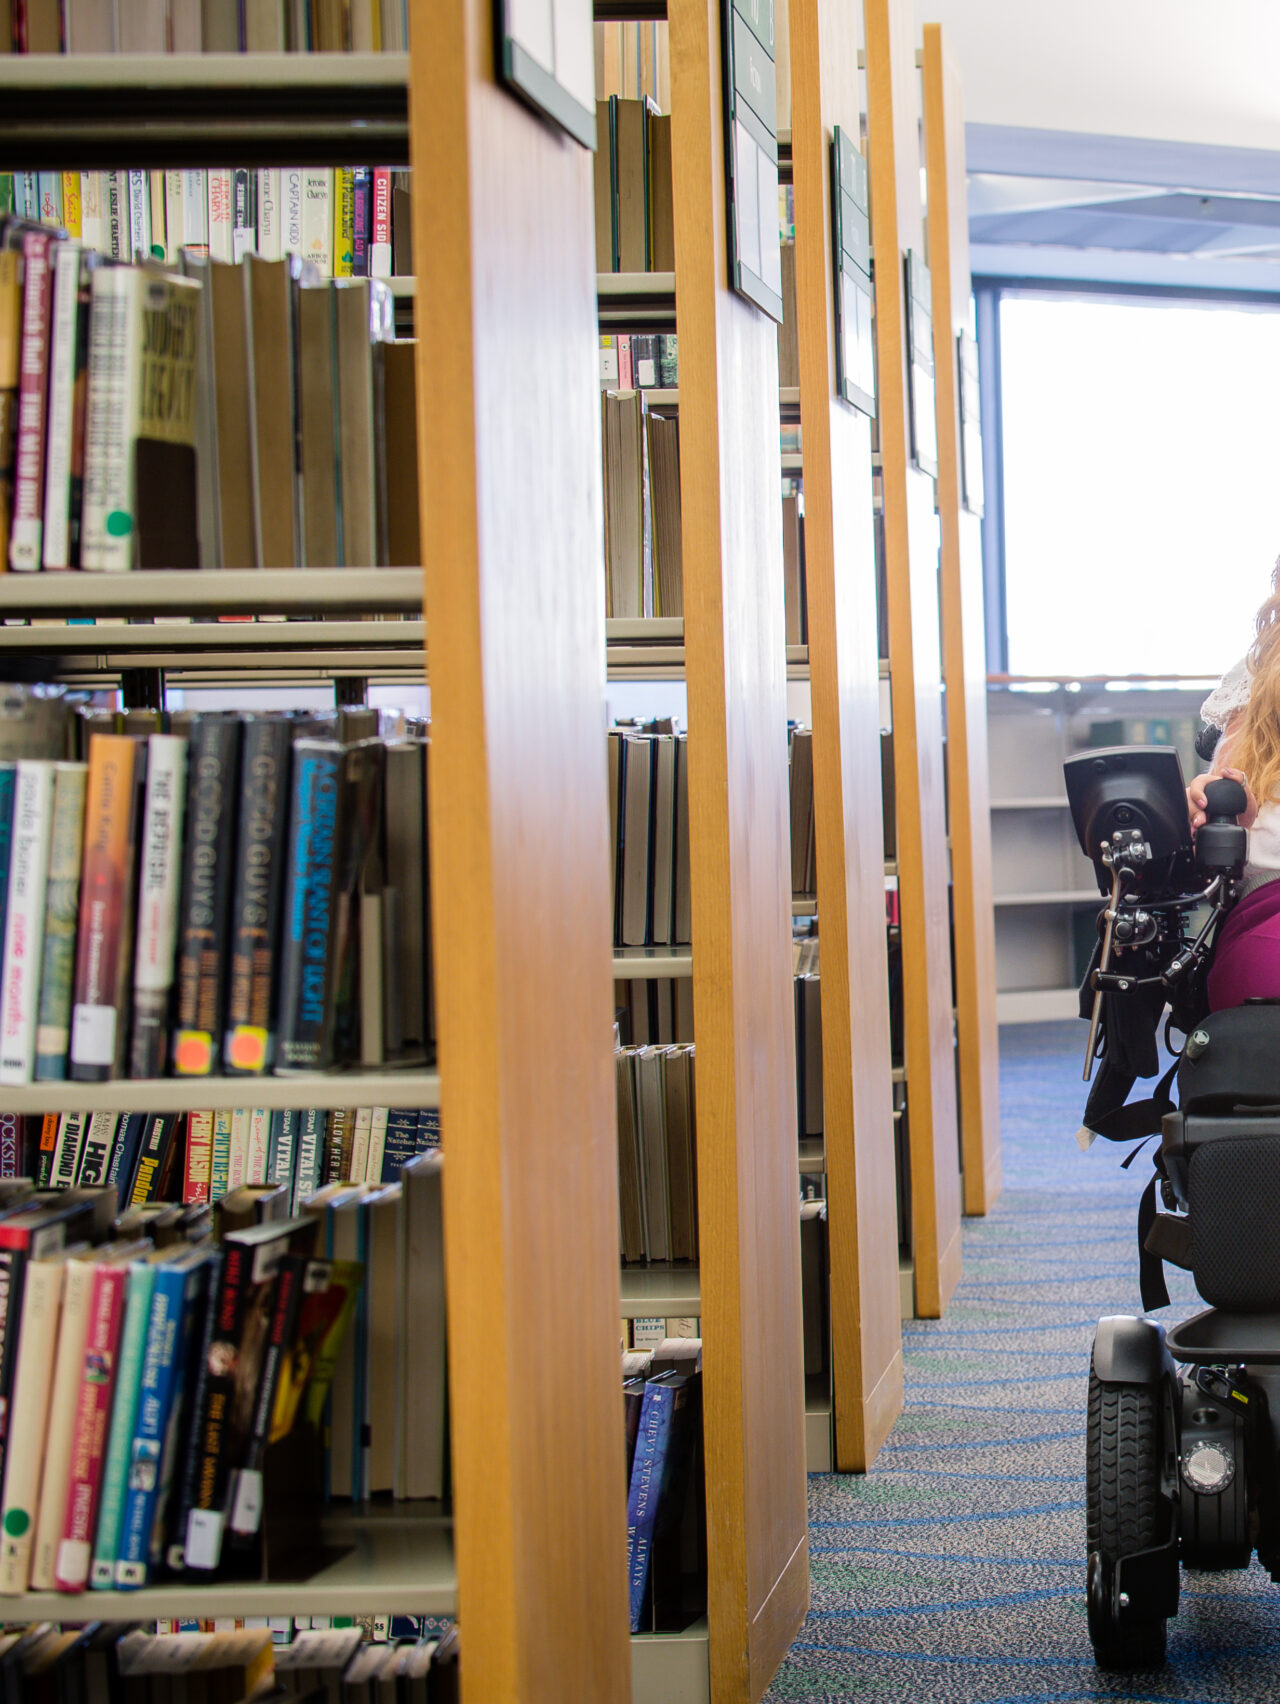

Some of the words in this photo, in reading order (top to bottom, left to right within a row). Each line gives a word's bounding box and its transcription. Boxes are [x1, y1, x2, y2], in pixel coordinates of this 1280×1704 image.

[110, 188, 118, 216] LESLIE
[211, 177, 221, 222] CHARYN
[290, 174, 299, 220] CAPTAIN
[377, 179, 387, 220] CITIZEN
[290, 223, 299, 245] KIDD
[354, 235, 364, 256] LADY
[153, 769, 171, 800] THE
[196, 755, 222, 841] GOOD
[251, 754, 276, 841] GOOD
[191, 845, 216, 925] GUYS
[243, 844, 270, 925] GUYS
[58, 1123, 80, 1177] DIAMOND
[108, 1143, 125, 1184] Chastain
[189, 1145, 211, 1182] MASON
[275, 1135, 292, 1178] VITAL
[299, 1134, 317, 1177] VITAL
[330, 1149, 341, 1166] HER
[645, 1411, 660, 1454] CHEVY
[636, 1459, 653, 1517] STEVENS
[632, 1537, 648, 1586] ALWAYS
